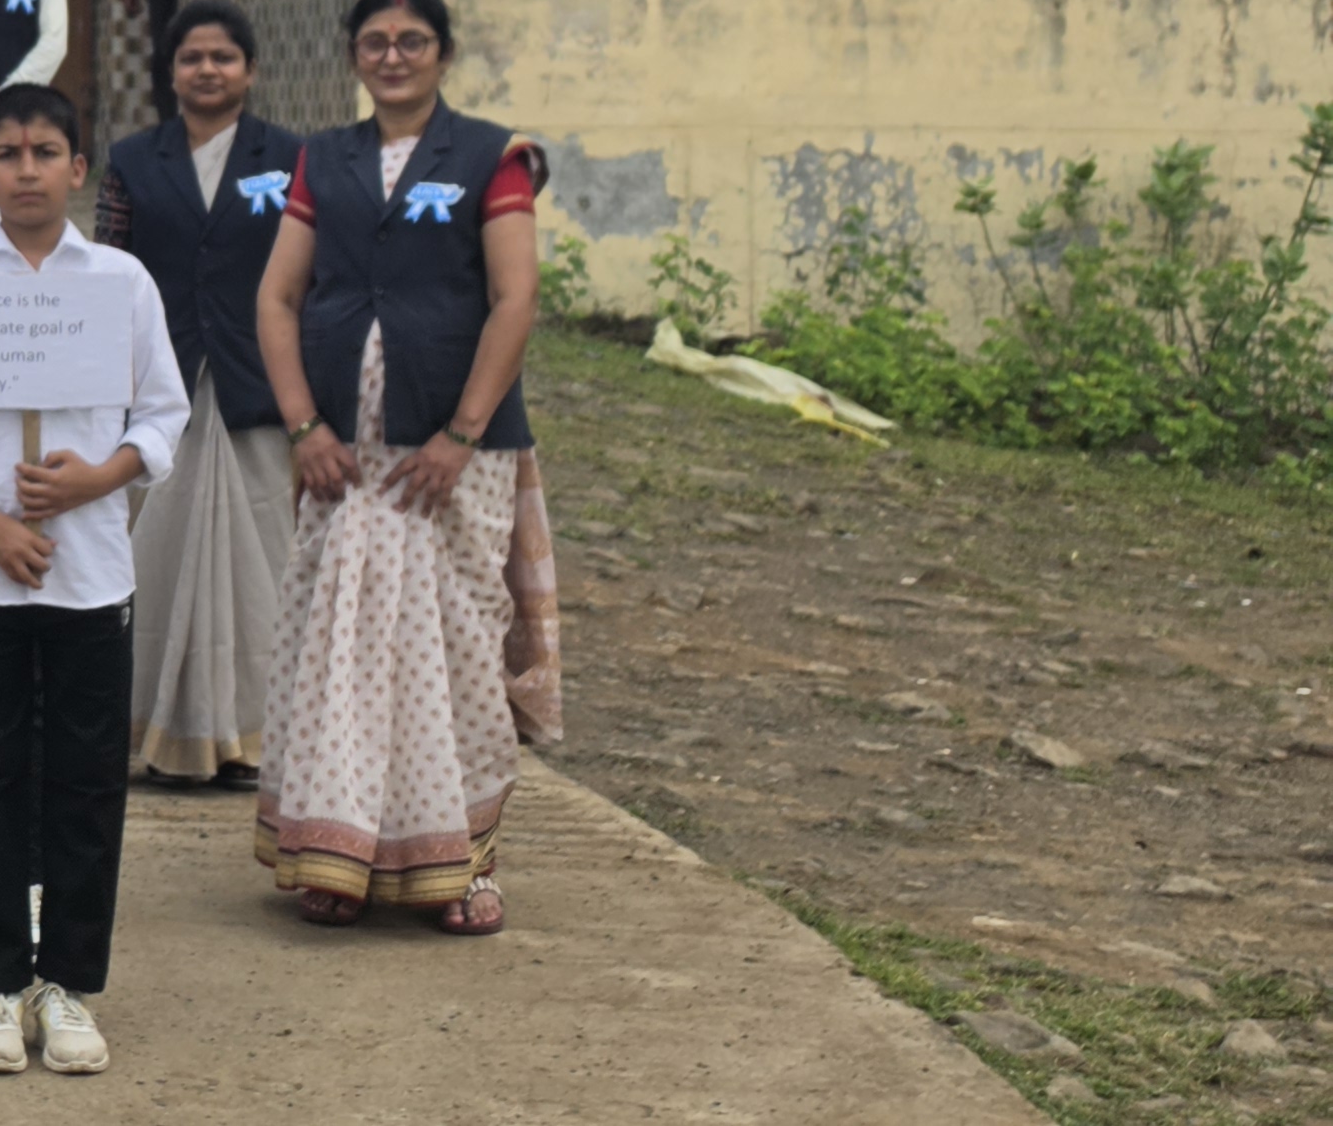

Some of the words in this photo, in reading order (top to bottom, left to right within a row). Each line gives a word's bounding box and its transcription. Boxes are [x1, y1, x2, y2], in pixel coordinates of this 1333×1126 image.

[17, 293, 29, 308] is
[34, 293, 61, 308] the
[30, 320, 63, 338] goal
[68, 320, 85, 335] of
